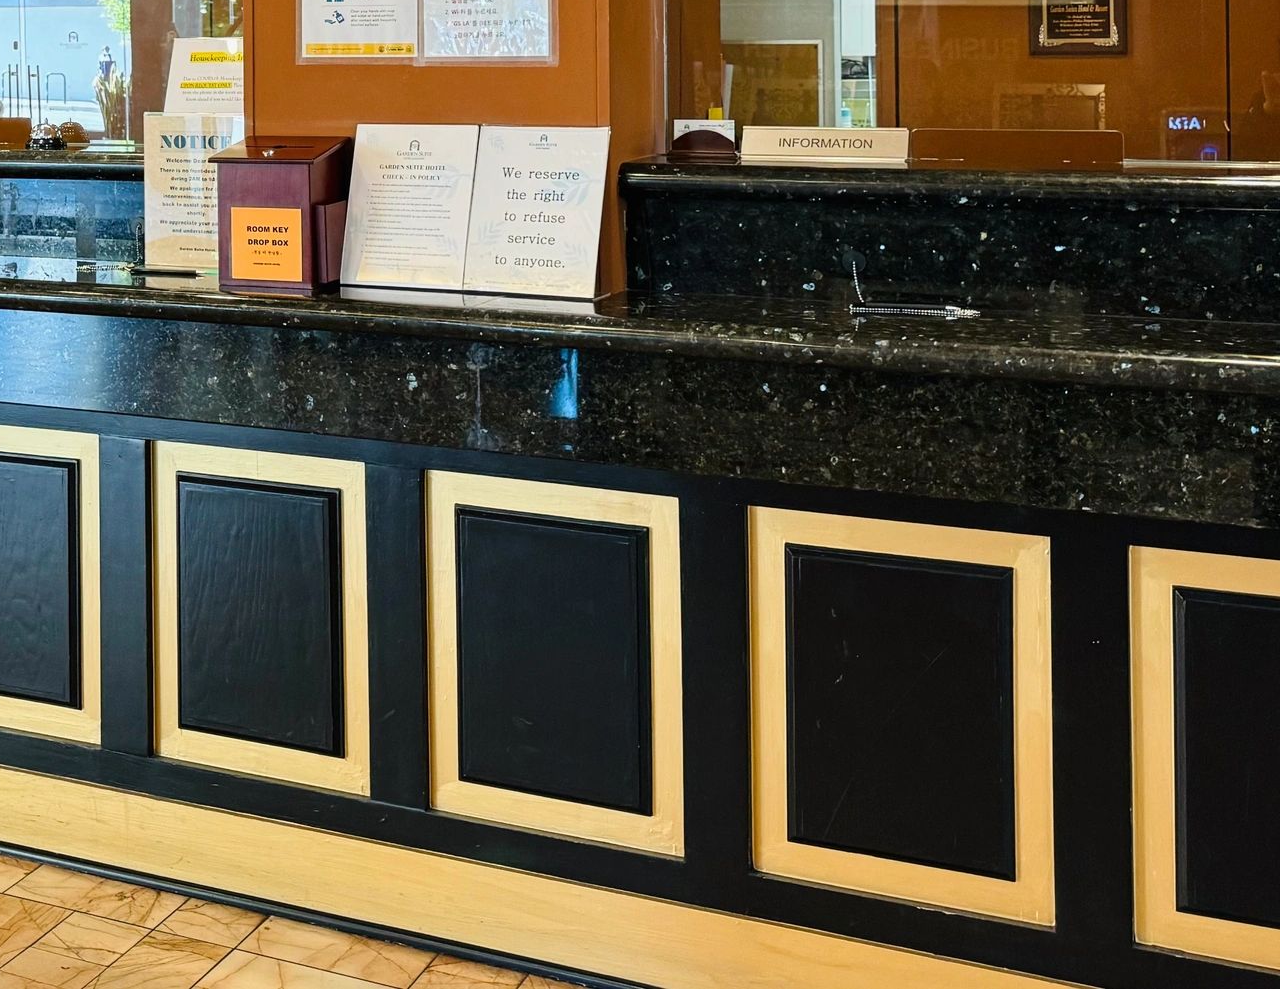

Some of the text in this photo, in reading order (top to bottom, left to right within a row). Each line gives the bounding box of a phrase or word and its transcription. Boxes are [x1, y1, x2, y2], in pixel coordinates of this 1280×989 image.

[778, 138, 874, 150] INFORMATION
[502, 166, 580, 181] We reserve
[506, 188, 565, 202] the right
[504, 211, 566, 224] to refuse
[272, 226, 289, 234] KEY
[248, 238, 270, 246] DROP
[507, 232, 556, 246] service
[495, 255, 566, 268] to anyone.
